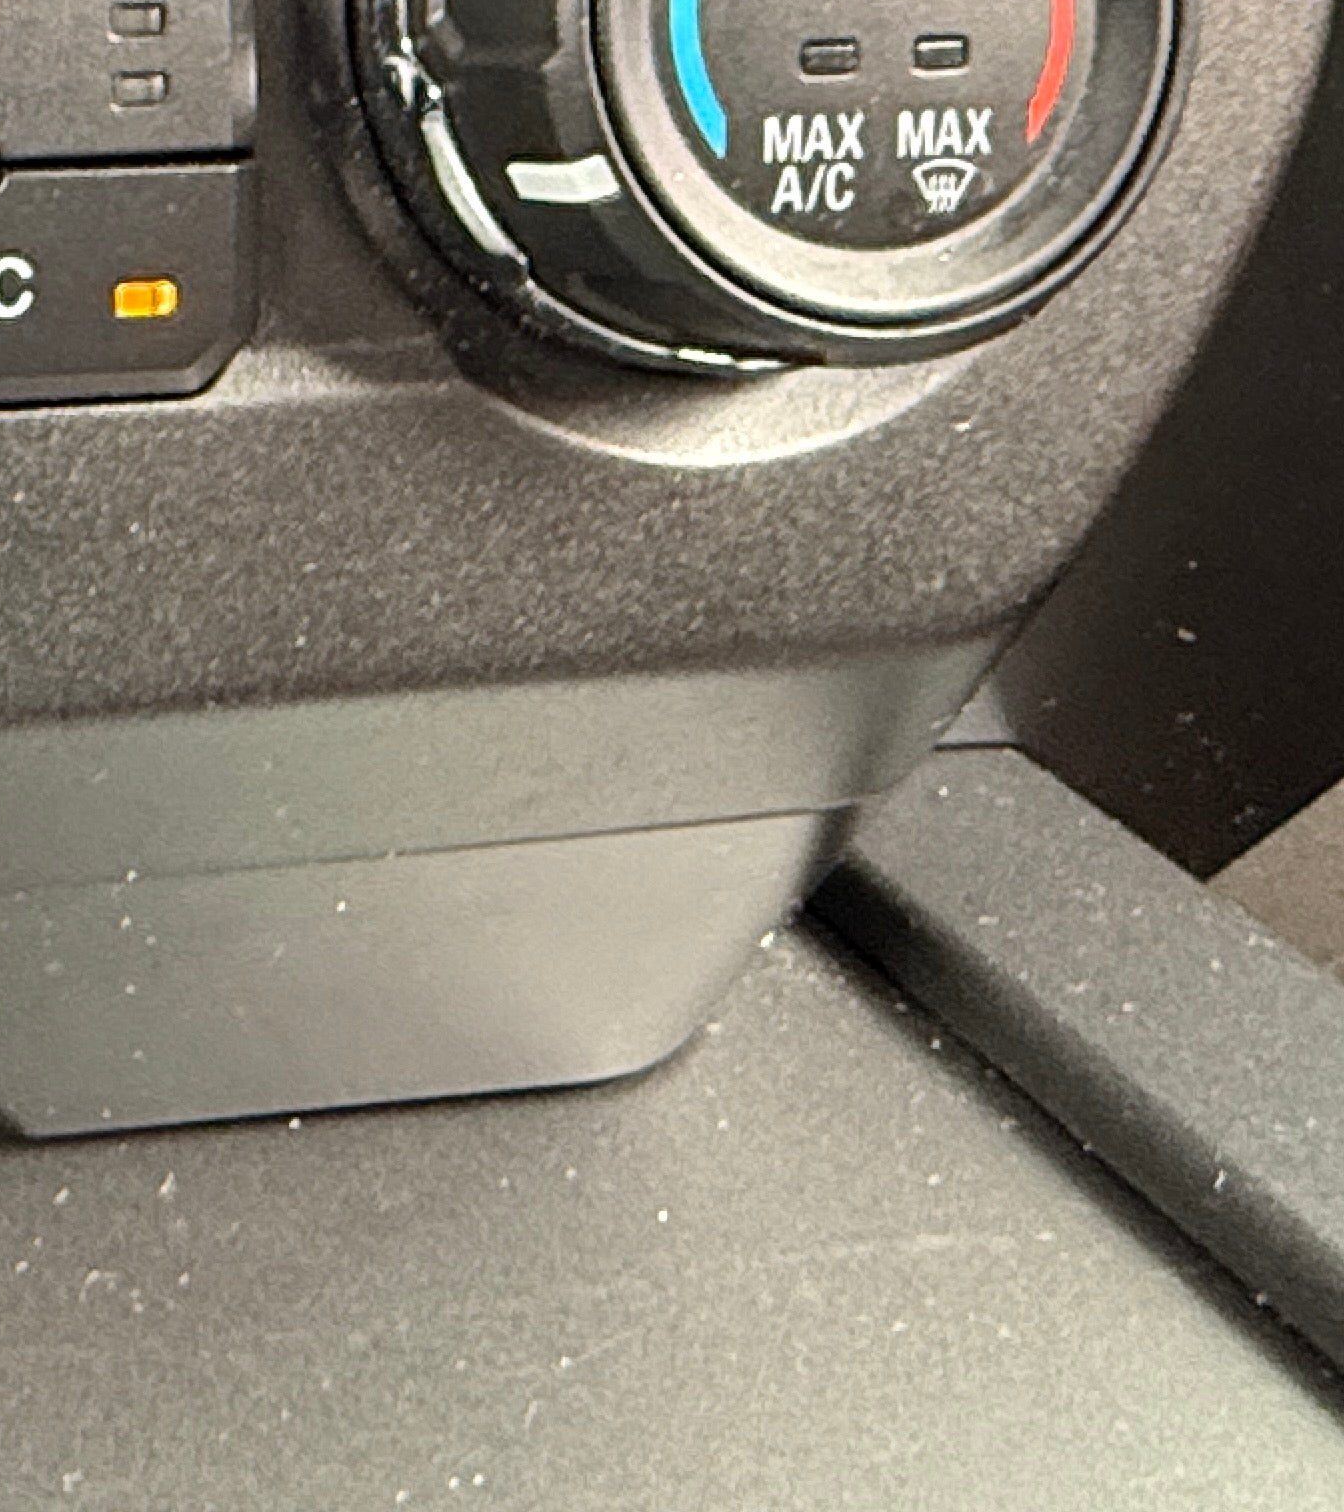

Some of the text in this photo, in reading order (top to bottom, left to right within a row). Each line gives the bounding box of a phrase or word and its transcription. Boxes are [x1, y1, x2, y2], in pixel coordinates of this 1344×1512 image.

[762, 109, 865, 164] MAX
[896, 107, 994, 159] MAX
[770, 163, 856, 214] A/C
